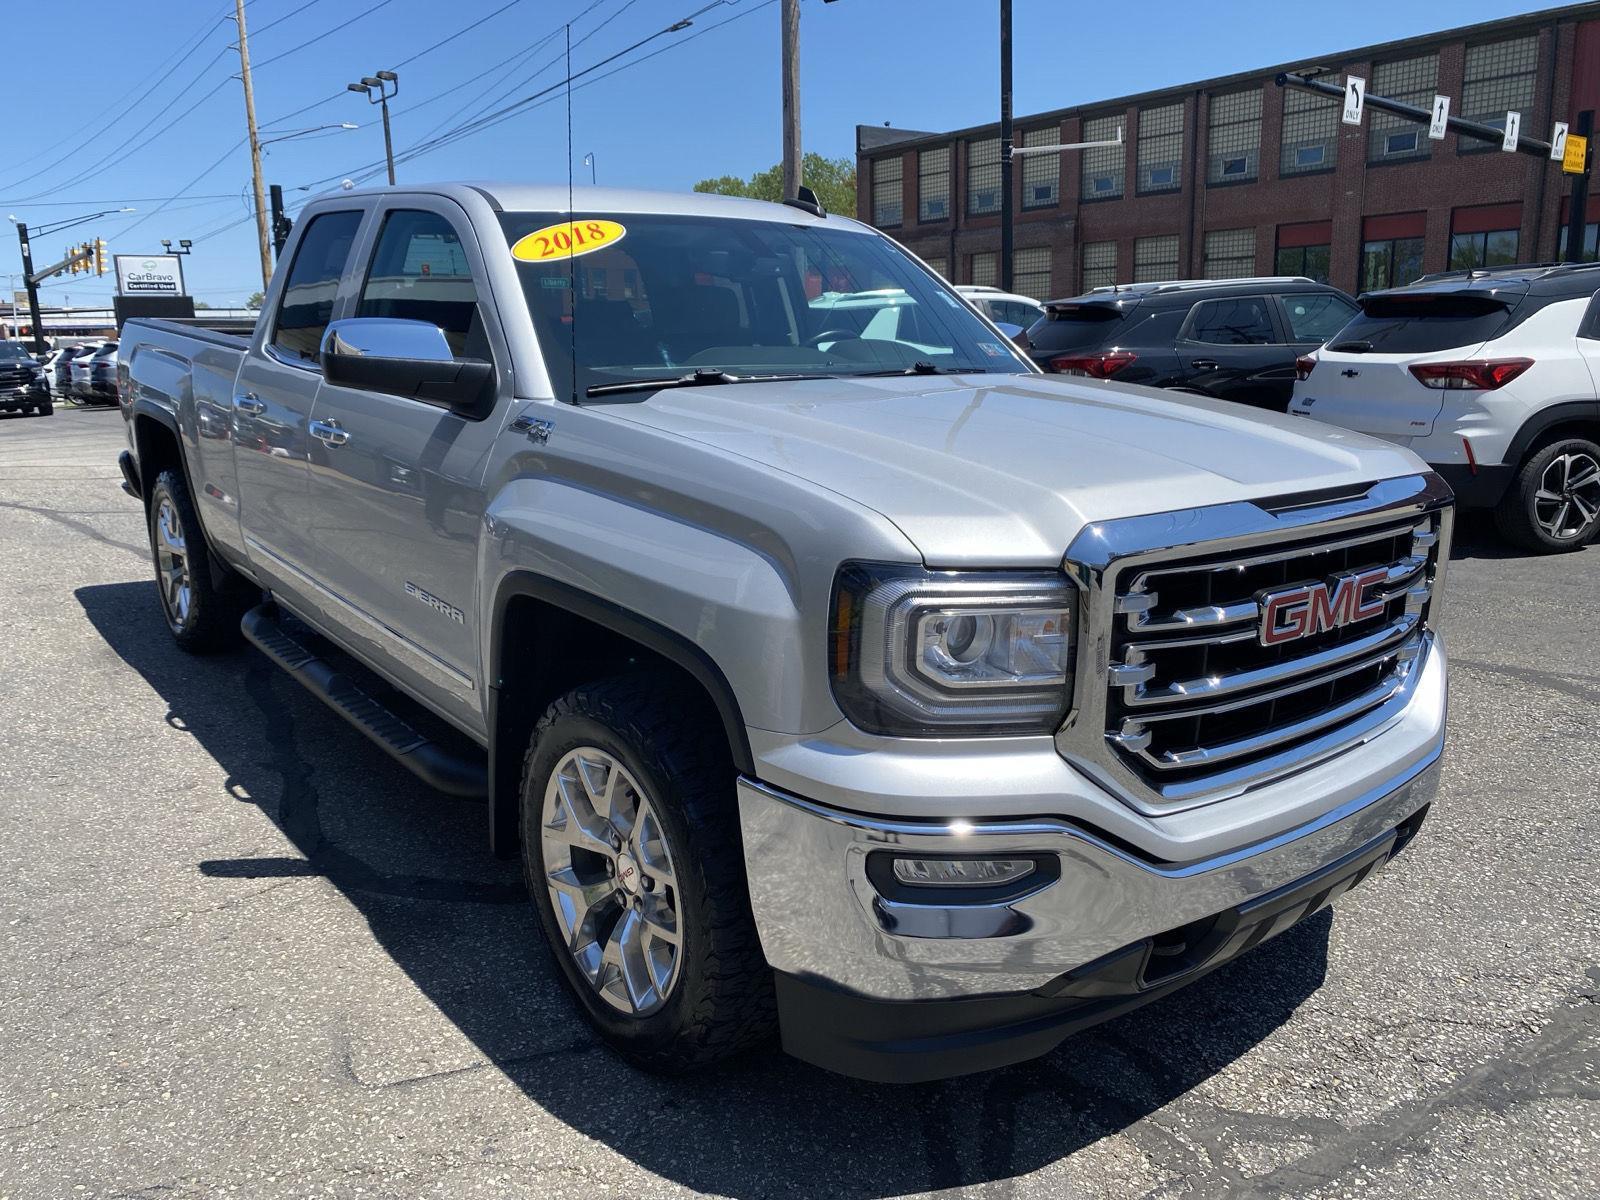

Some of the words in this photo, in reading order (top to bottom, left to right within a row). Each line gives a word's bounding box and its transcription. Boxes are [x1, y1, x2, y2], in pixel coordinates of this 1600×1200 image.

[1345, 110, 1360, 120] ONLY
[1431, 124, 1444, 134] ONLY
[1505, 138, 1516, 147] ONLY
[535, 222, 605, 257] 2018
[128, 272, 173, 281] CarBravo
[404, 580, 465, 625] SIERRA
[1260, 567, 1389, 647] GMC
